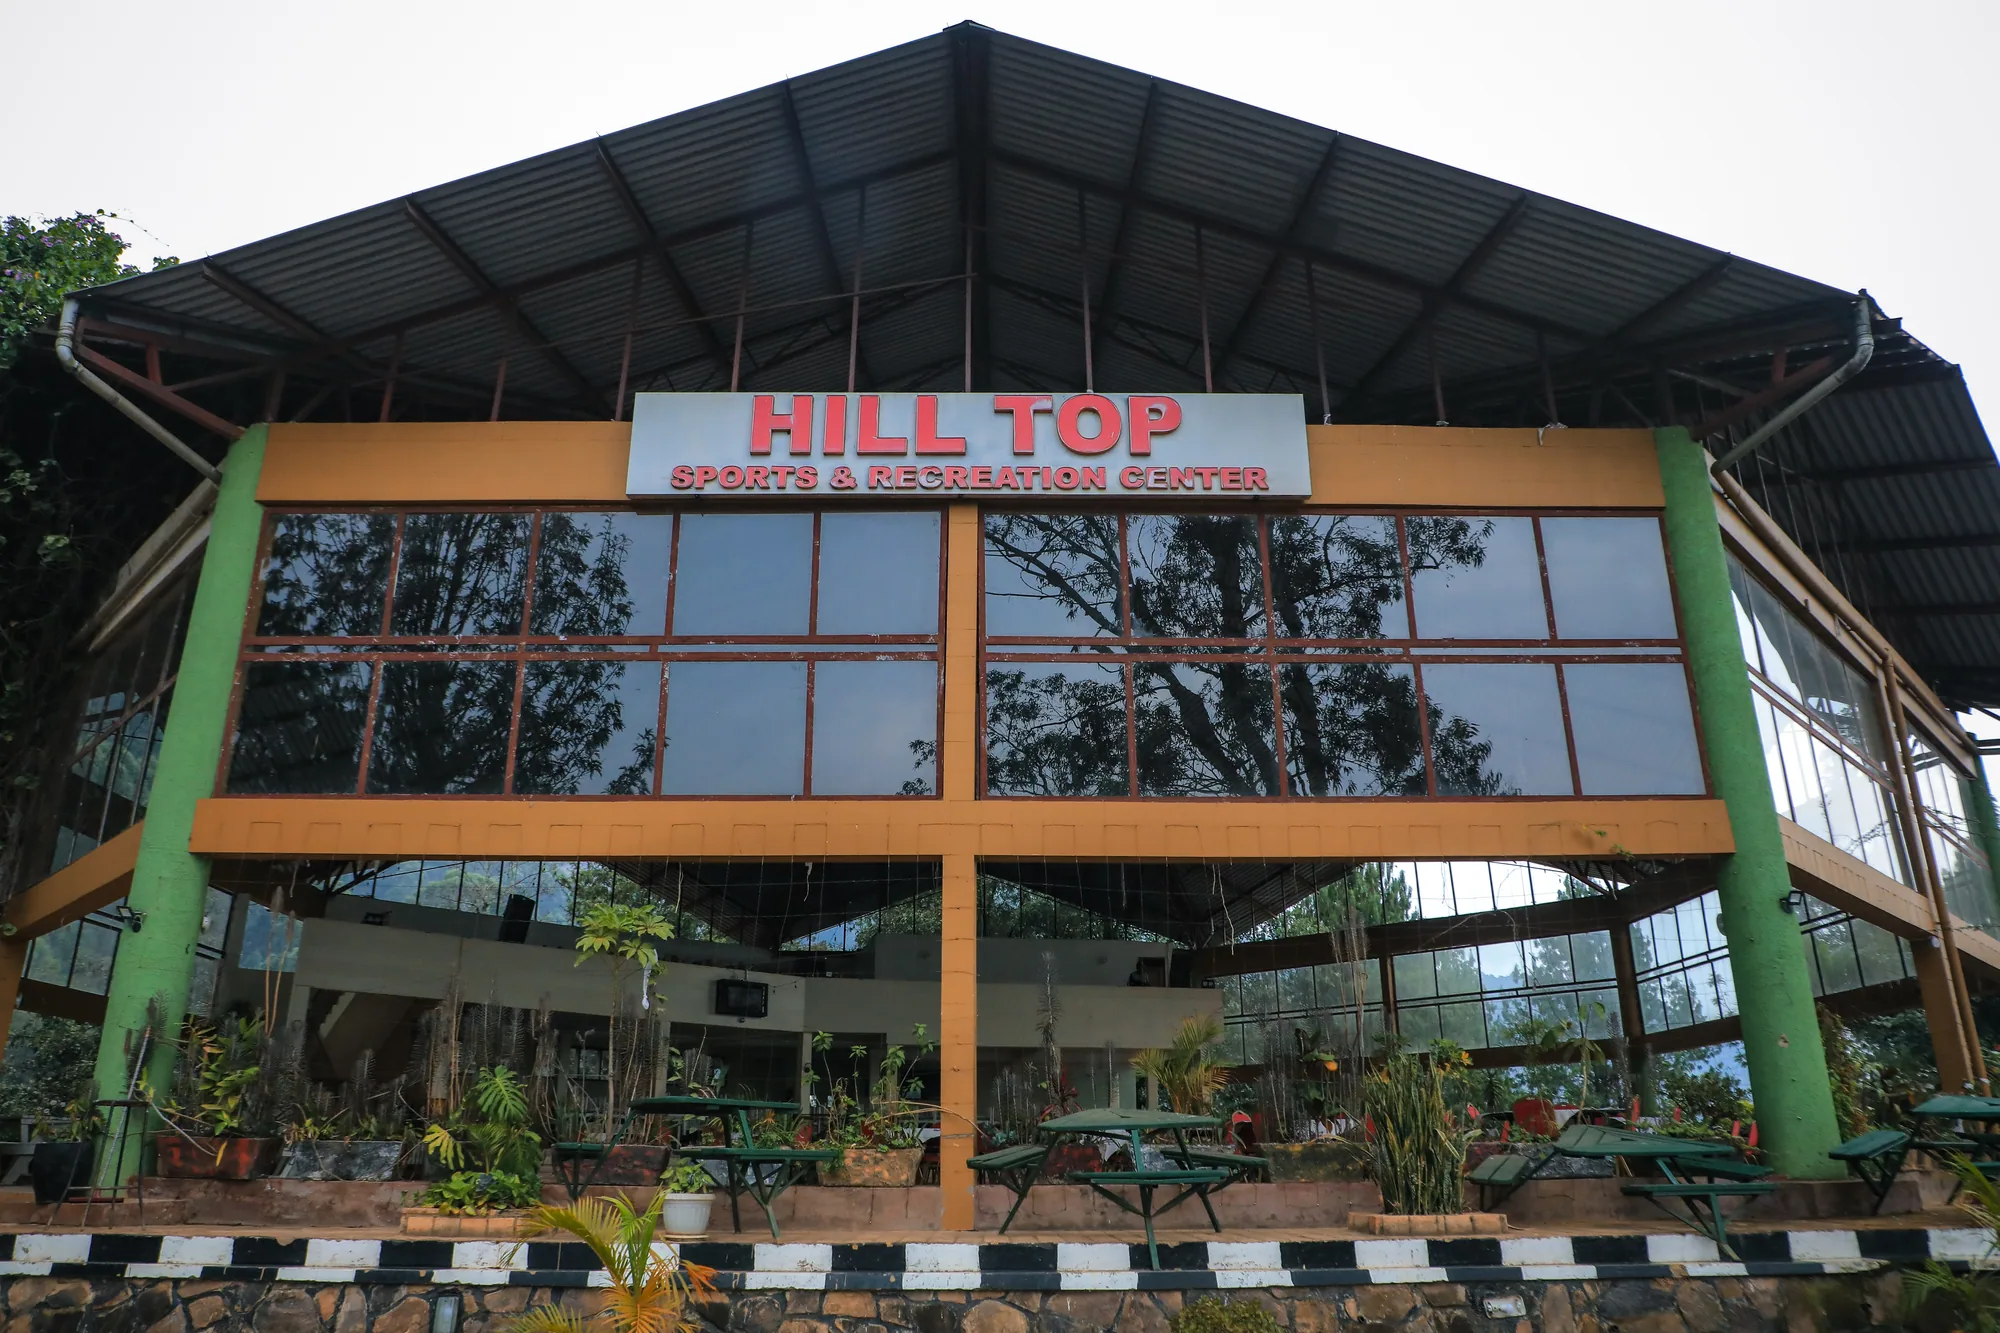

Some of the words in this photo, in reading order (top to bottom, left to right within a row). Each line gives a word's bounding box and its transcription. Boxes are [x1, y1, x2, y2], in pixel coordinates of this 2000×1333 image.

[750, 394, 966, 456] HILL
[994, 394, 1182, 456] TOP
[671, 465, 818, 489] SPORTS
[831, 466, 857, 489] &
[868, 465, 1107, 490] RECREATION
[1119, 466, 1269, 490] CENTER
